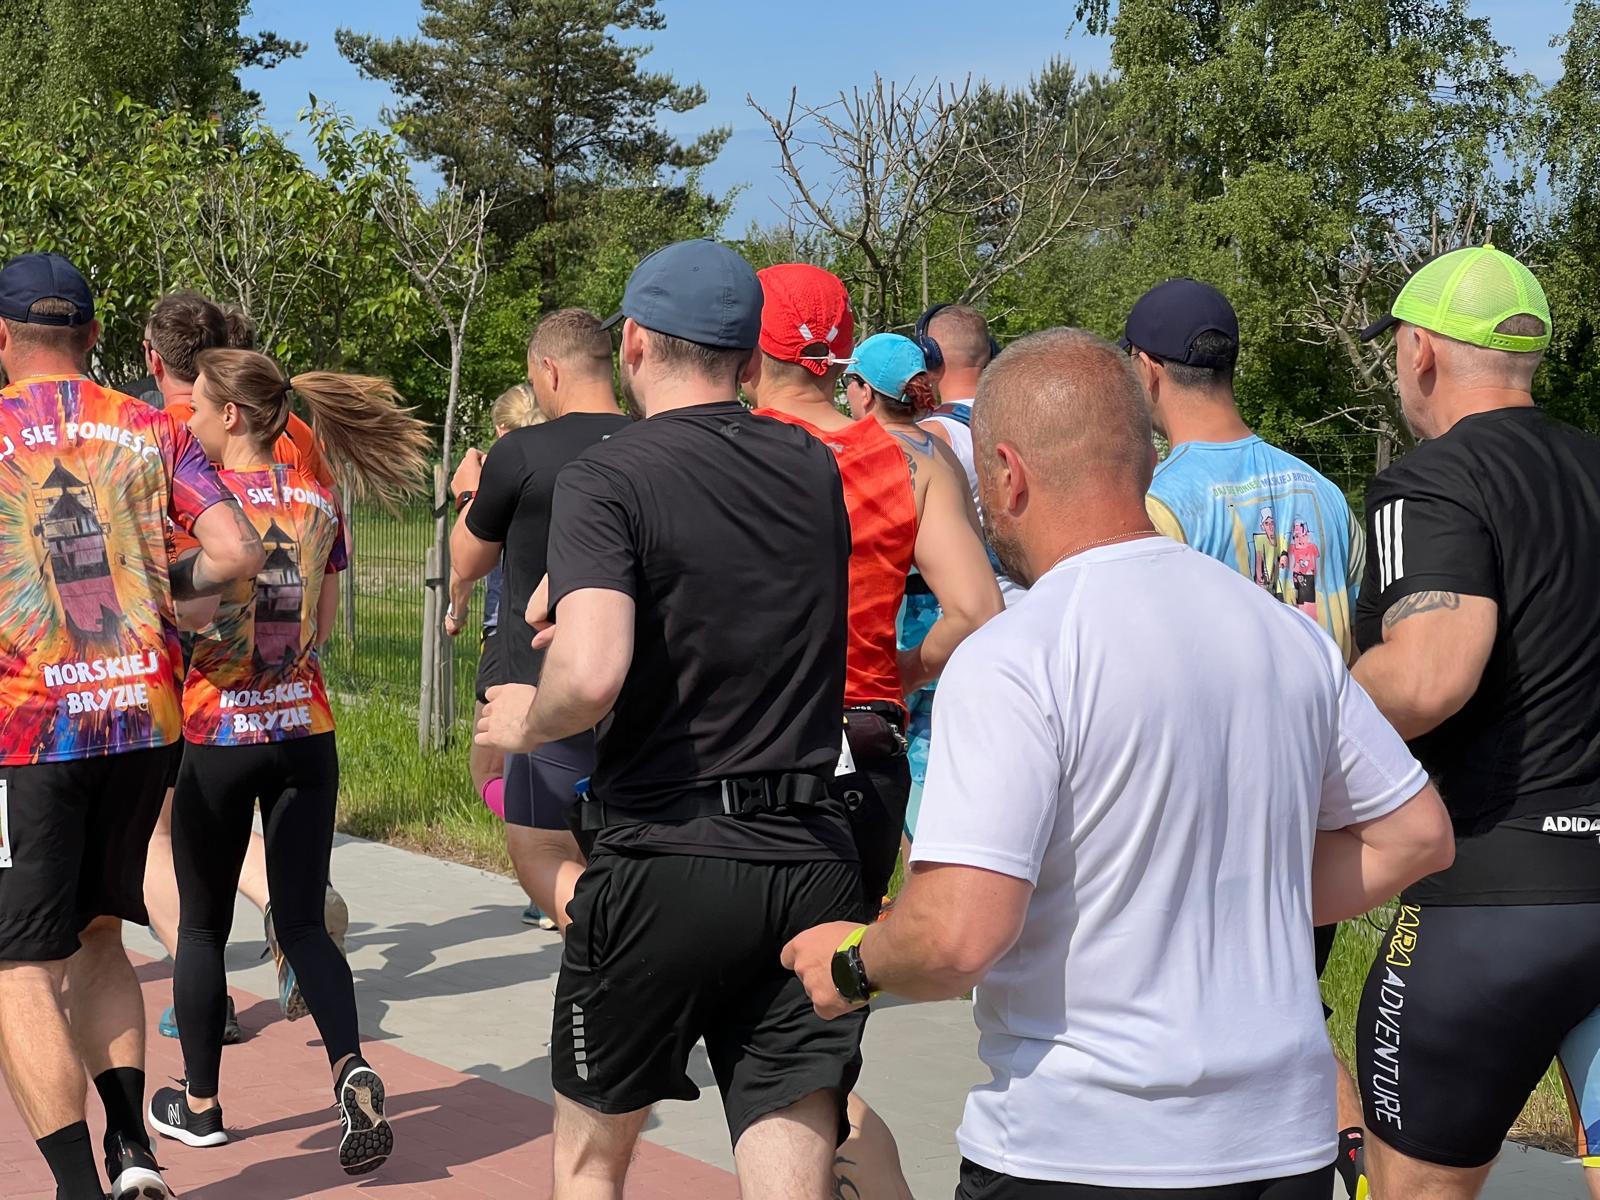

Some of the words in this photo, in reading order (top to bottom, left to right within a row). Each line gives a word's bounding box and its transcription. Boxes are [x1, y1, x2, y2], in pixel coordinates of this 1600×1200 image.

[21, 424, 58, 446] SIĘ
[44, 652, 158, 687] MORSKIEJ
[67, 684, 149, 714] BRYZIE
[220, 680, 312, 708] MORSKIEJ
[233, 706, 312, 733] BRYZIE
[1372, 965, 1406, 1130] ADVENTURE
